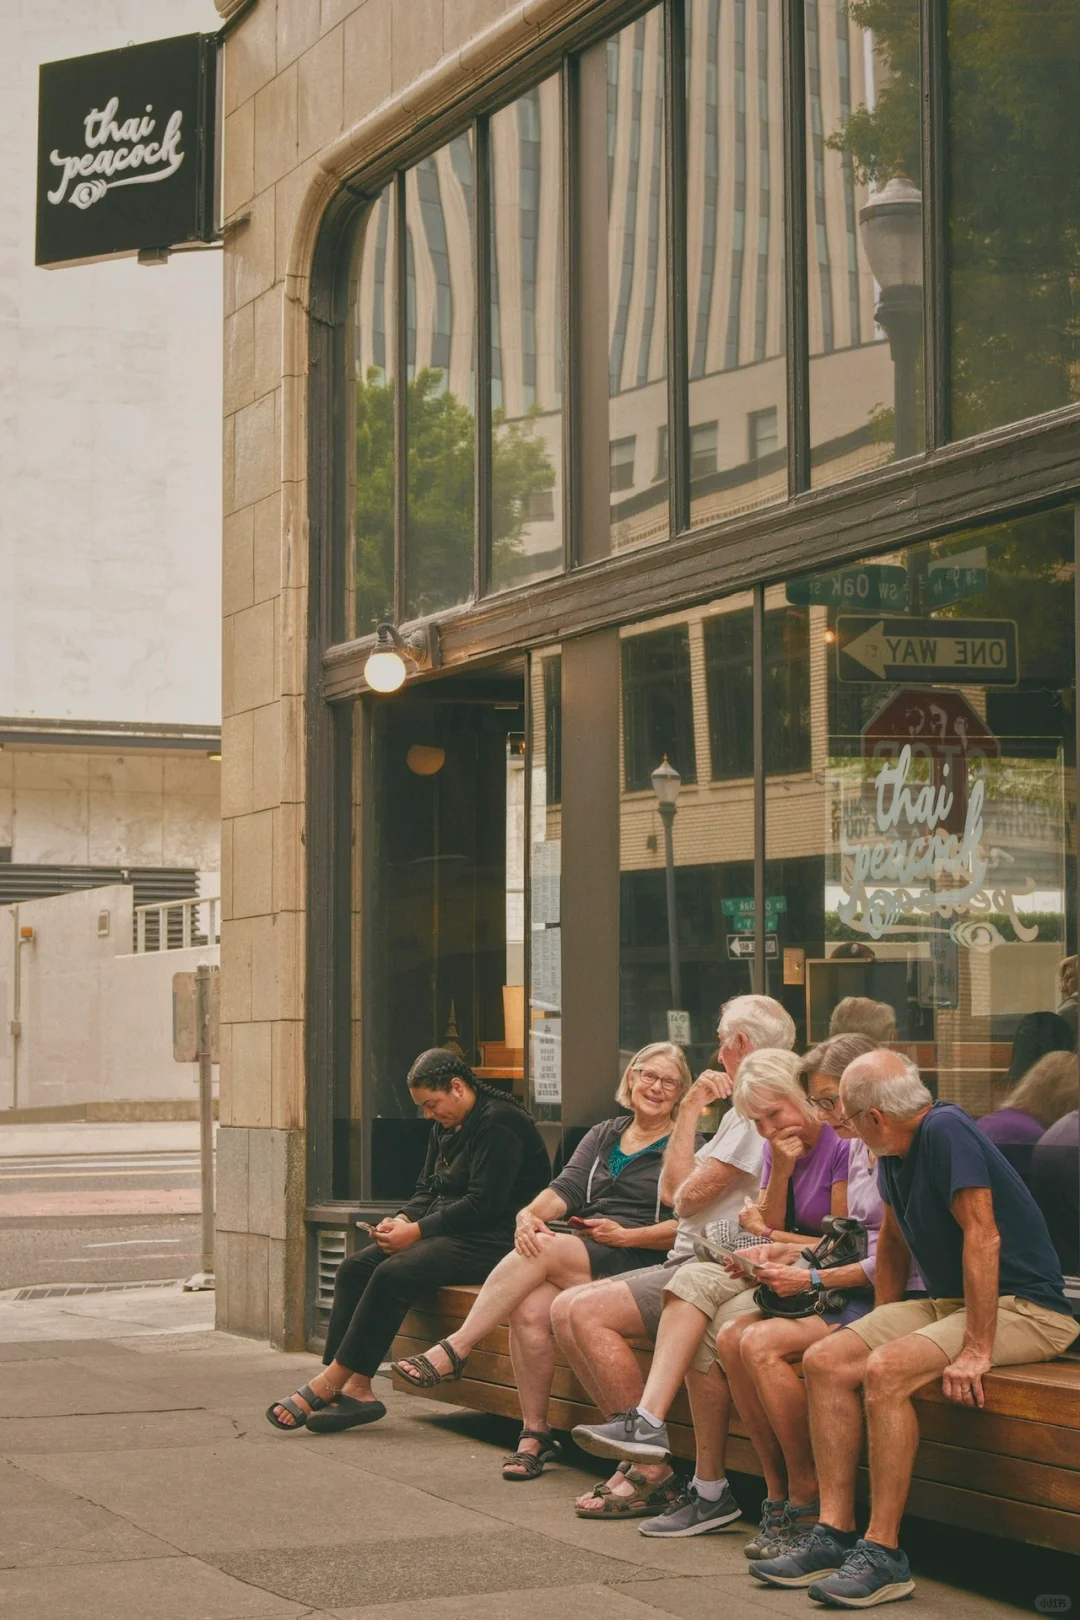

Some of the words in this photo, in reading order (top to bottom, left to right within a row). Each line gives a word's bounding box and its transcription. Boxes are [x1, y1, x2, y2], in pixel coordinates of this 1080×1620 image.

[47, 110, 185, 206] peacock
[83, 96, 156, 149] thai
[875, 743, 954, 833] thai
